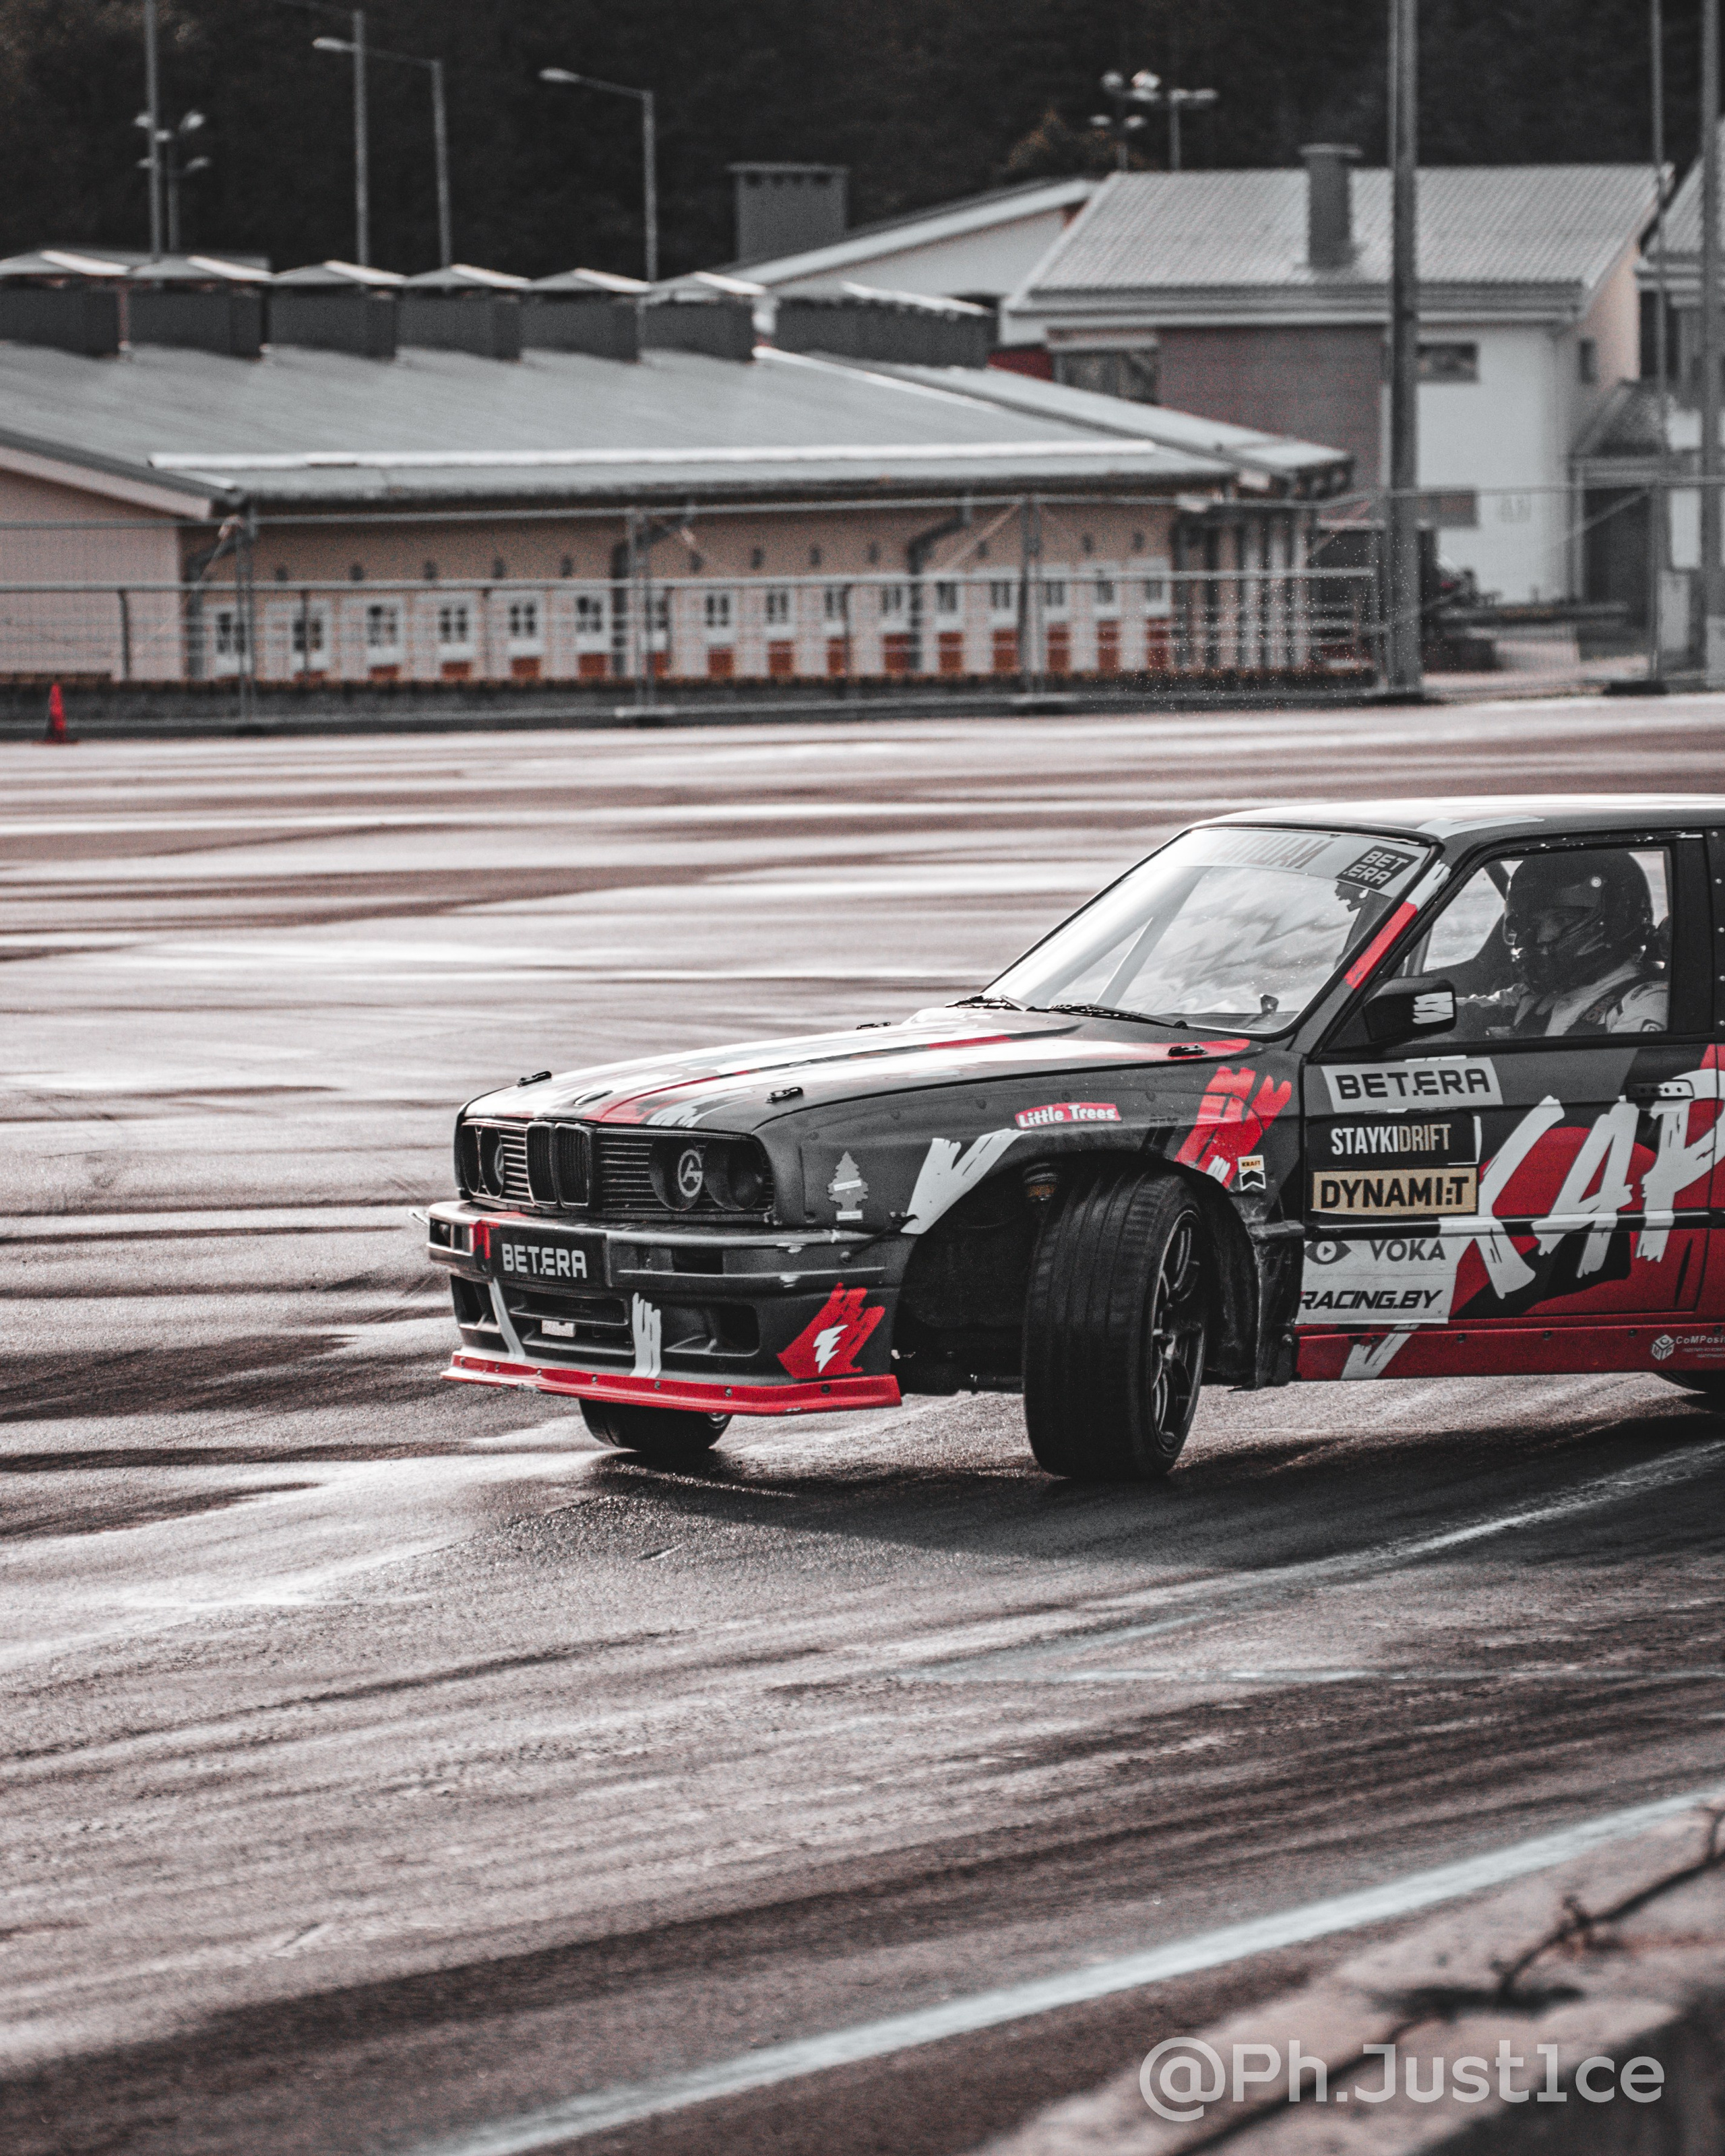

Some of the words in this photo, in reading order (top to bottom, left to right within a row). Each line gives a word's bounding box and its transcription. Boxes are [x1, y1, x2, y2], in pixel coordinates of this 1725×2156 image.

[1361, 850, 1409, 870] BET
[1018, 1106, 1065, 1128] Little
[1068, 1104, 1116, 1120] Trees
[1369, 1238, 1446, 1261] VOKA
